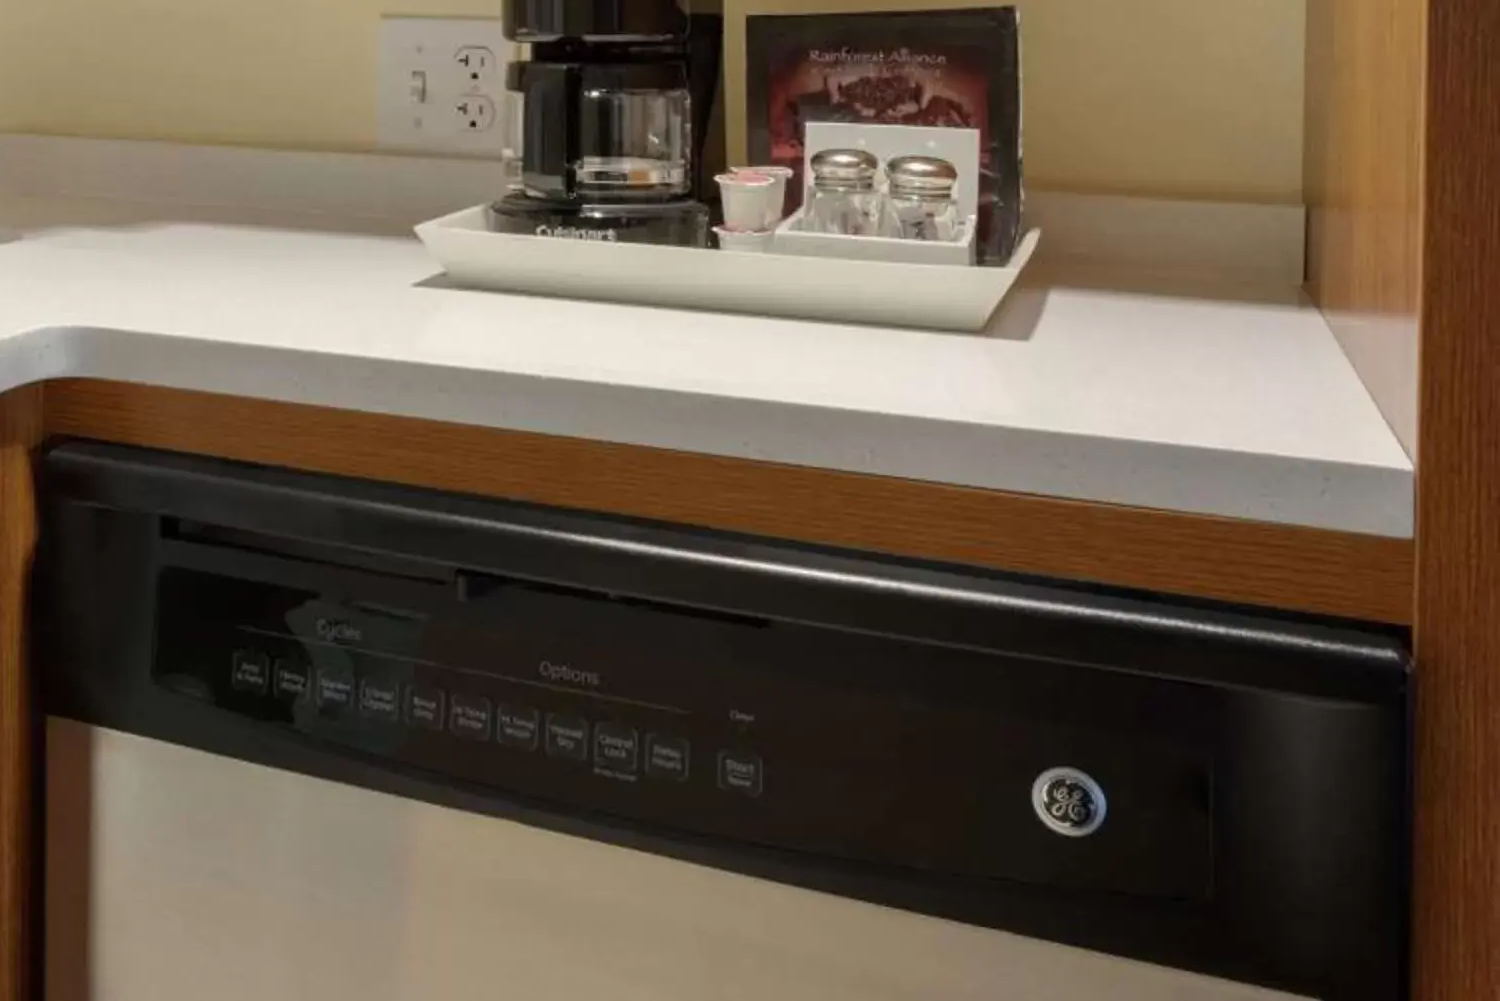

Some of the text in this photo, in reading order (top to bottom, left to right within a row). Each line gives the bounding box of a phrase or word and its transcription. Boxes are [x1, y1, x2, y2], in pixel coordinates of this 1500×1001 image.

[809, 46, 947, 65] Rainforest Alliance
[535, 224, 618, 240] Cuisinart
[538, 660, 600, 686] Options
